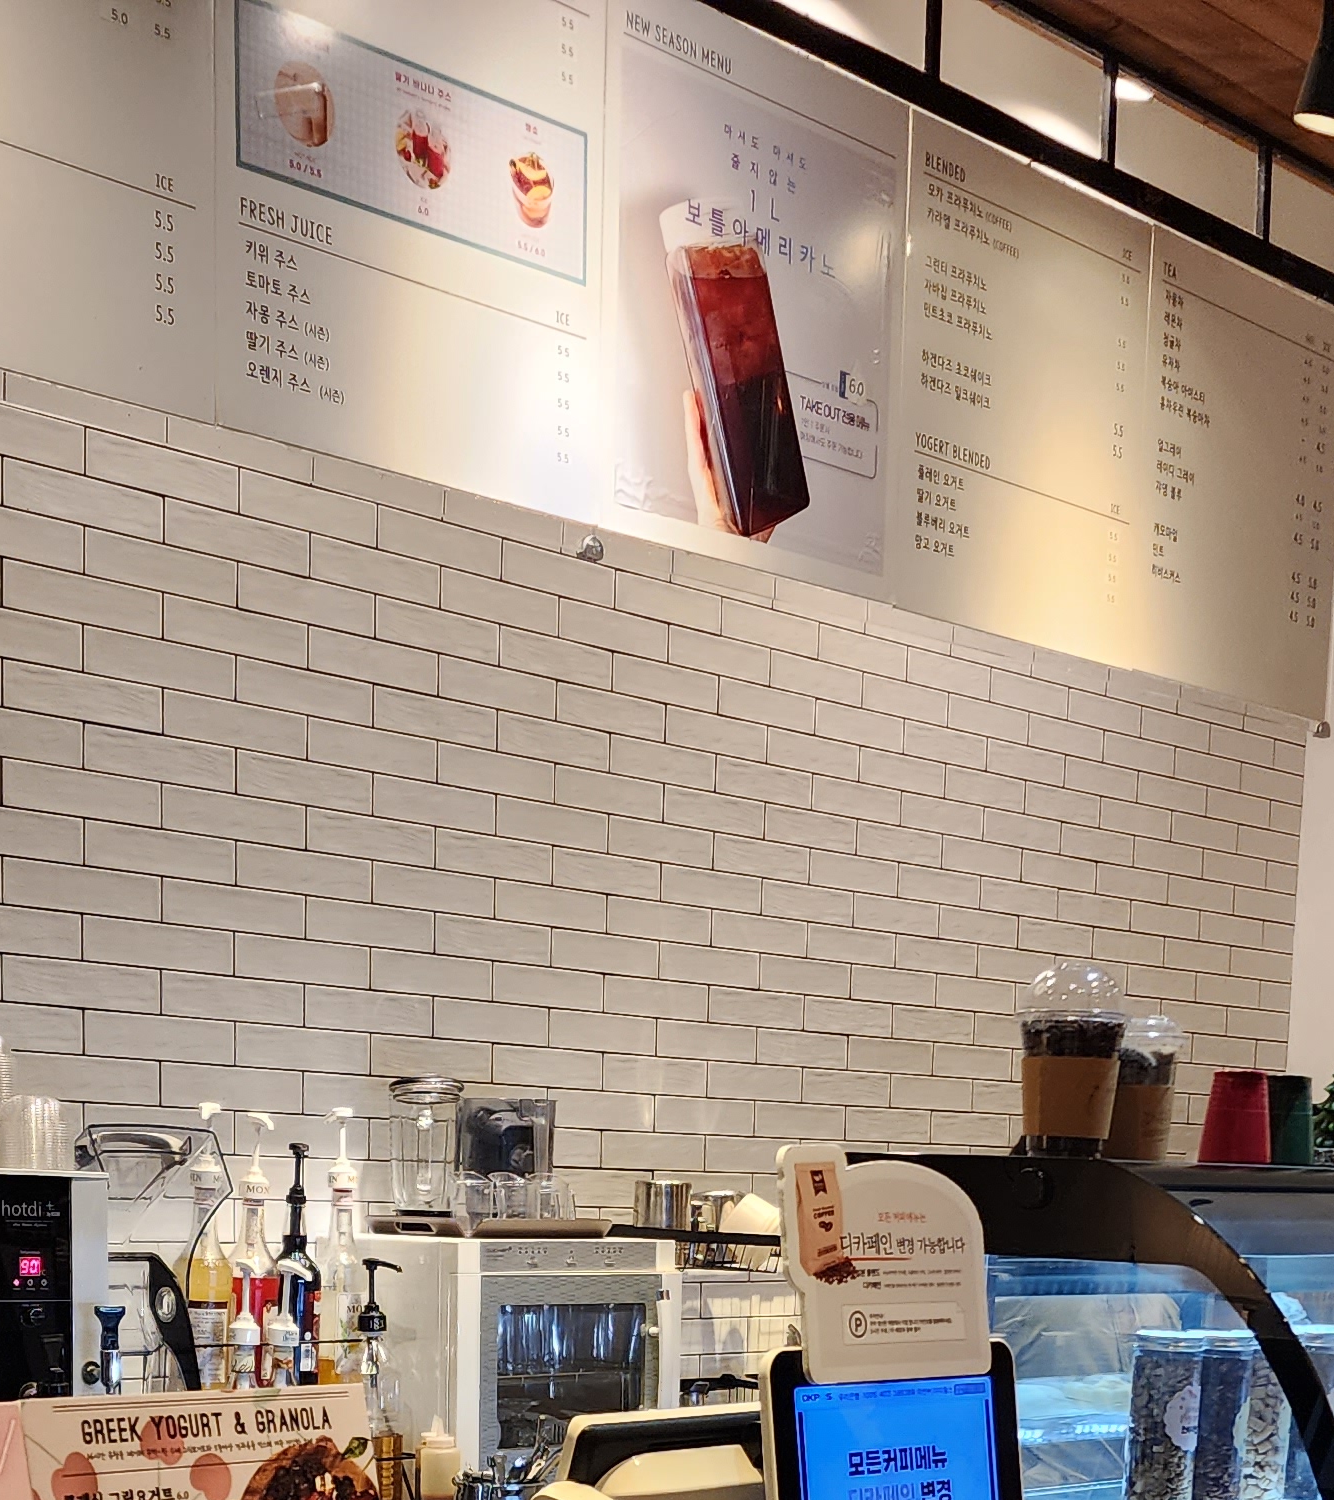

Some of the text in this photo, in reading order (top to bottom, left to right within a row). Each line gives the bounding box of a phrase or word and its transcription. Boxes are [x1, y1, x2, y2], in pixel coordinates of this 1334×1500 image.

[111, 8, 128, 25] 5.0
[154, 23, 171, 39] 5.5
[626, 10, 732, 75] NEW SEASON MENU
[925, 151, 966, 183] BLENDED
[155, 174, 174, 193] ICE
[928, 183, 944, 203] 모카
[154, 210, 174, 233] 5.5
[239, 195, 333, 246] FRESH JUICE
[154, 242, 174, 264] 5.5
[245, 239, 299, 272] 키위 주스
[1163, 261, 1177, 280] TEA
[154, 273, 175, 295] 5.5
[245, 270, 312, 306] 토마토 주스
[155, 305, 175, 326] 5.5
[245, 300, 331, 343] 자몽 주스 (시즌)
[555, 310, 571, 327] ICE
[245, 330, 331, 372] 딸기 주스 (시즌)
[245, 361, 345, 406] 오렌지 주스 (시즌)
[915, 431, 991, 471] YOGERT BLENDED
[943, 473, 965, 491] 요거트
[935, 493, 957, 512] 요거트
[948, 520, 970, 539] 요거트
[933, 539, 955, 558] 요거트
[840, 1232, 966, 1255] 디카페인 변경 가능합니다
[20, 1259, 40, 1274] 90
[81, 1406, 333, 1445] GREEK YOGURT & GRANOLA
[848, 1445, 948, 1477] 모든커피메뉴
[177, 1490, 190, 1500] 6.0
